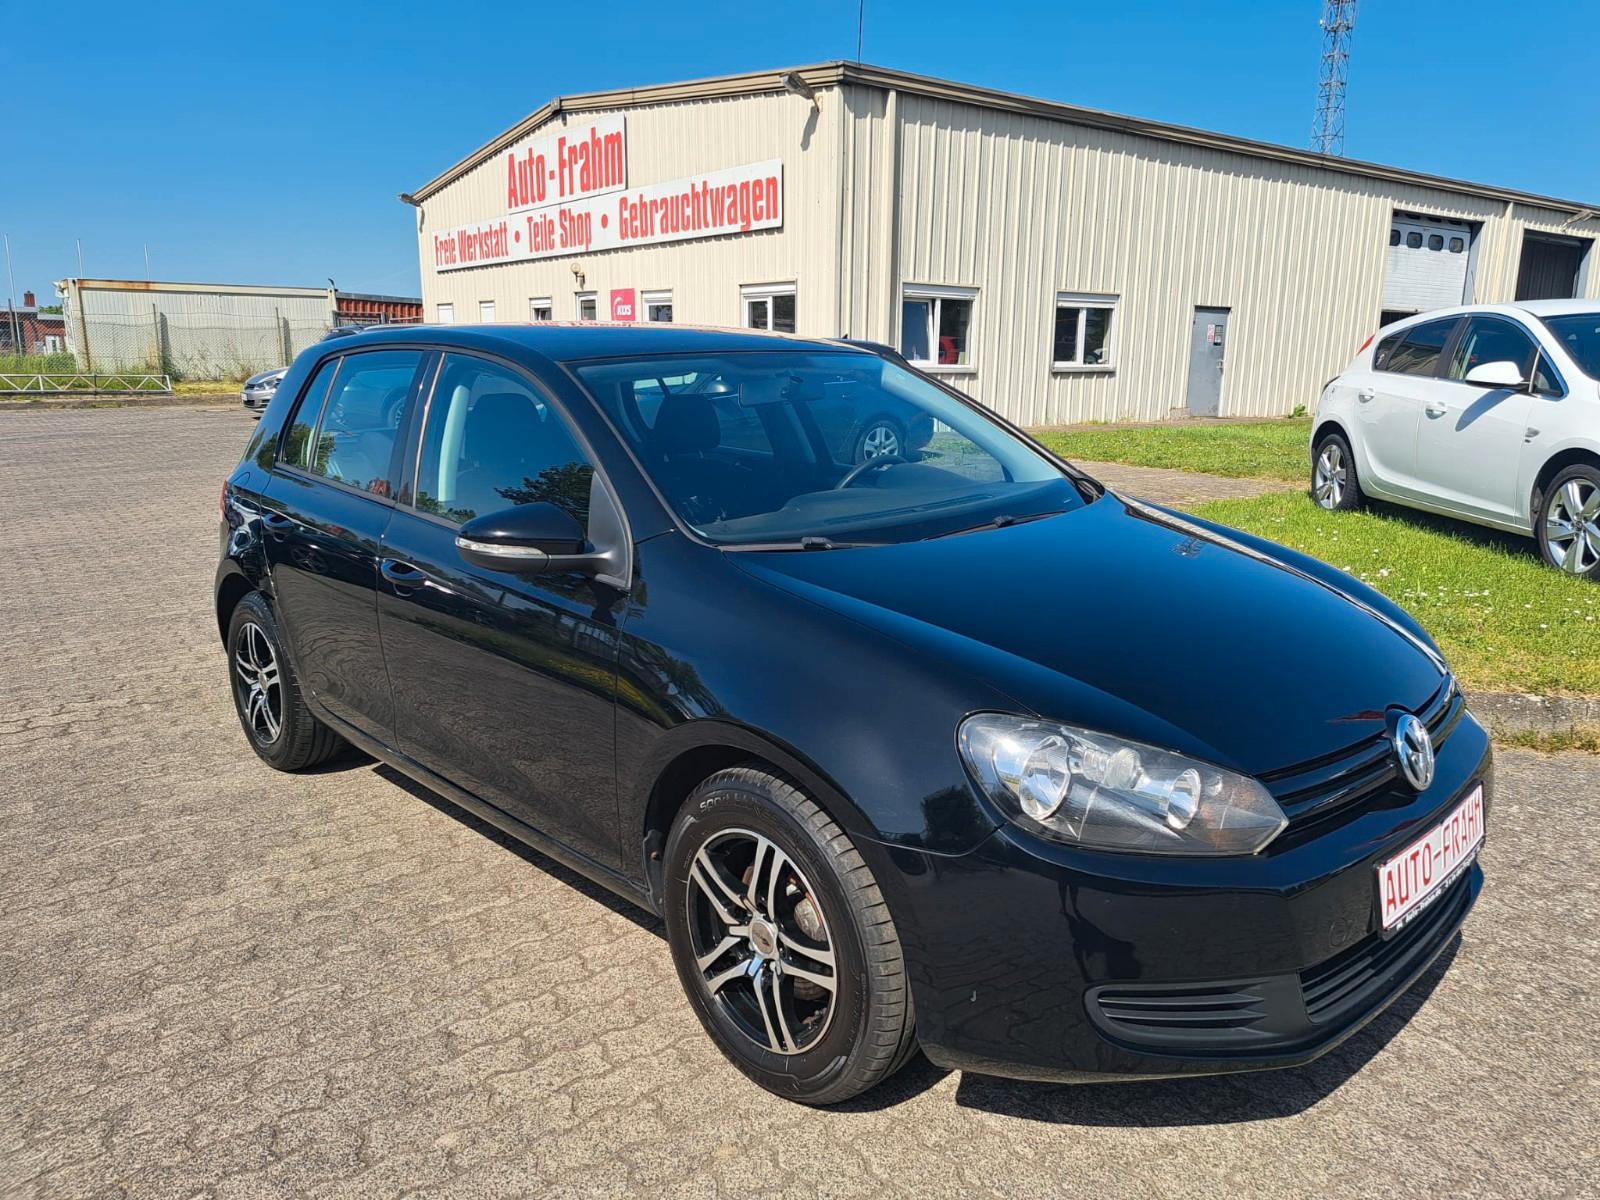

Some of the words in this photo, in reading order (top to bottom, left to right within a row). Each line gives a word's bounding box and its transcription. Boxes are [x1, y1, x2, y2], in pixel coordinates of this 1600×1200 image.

[508, 127, 624, 209] Auto-Frahm
[434, 233, 457, 266] Freie
[457, 221, 509, 263] Werkstatt
[527, 213, 555, 253] Teile
[559, 208, 592, 251] Shop
[619, 176, 778, 240] Gebrauchtwagen
